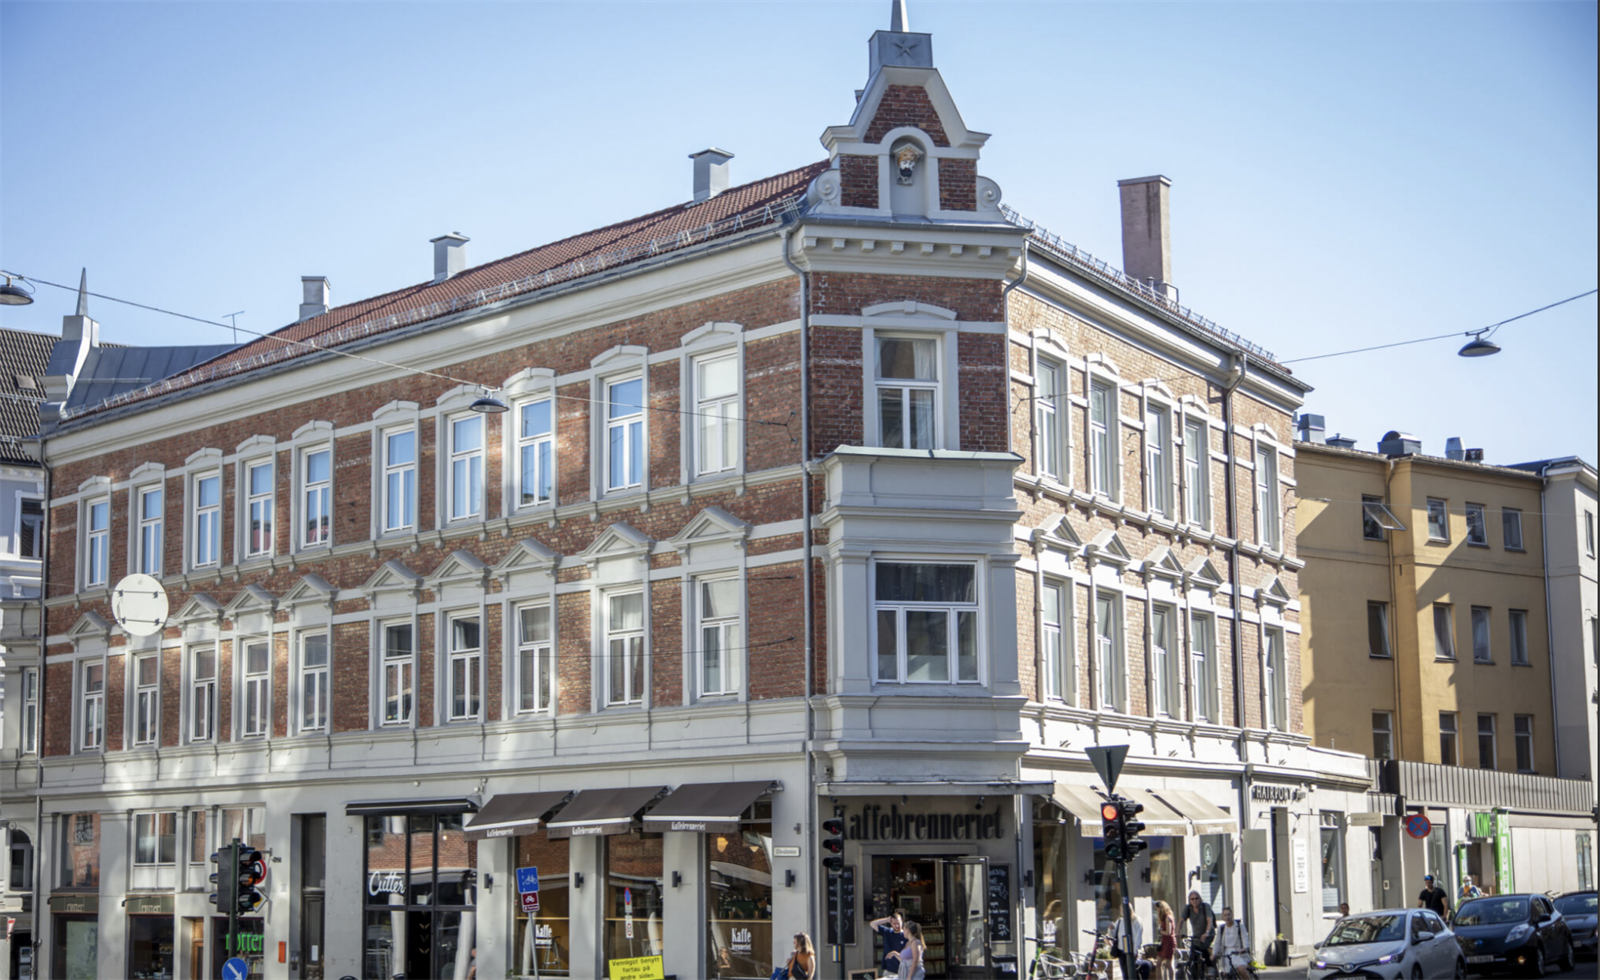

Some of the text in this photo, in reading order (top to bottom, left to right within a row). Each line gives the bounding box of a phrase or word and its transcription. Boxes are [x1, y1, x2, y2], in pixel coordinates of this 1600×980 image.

[1475, 813, 1492, 838] KIWI
[368, 870, 406, 896] Cutter
[535, 924, 553, 937] Kaffe
[731, 927, 752, 943] Kaffe
